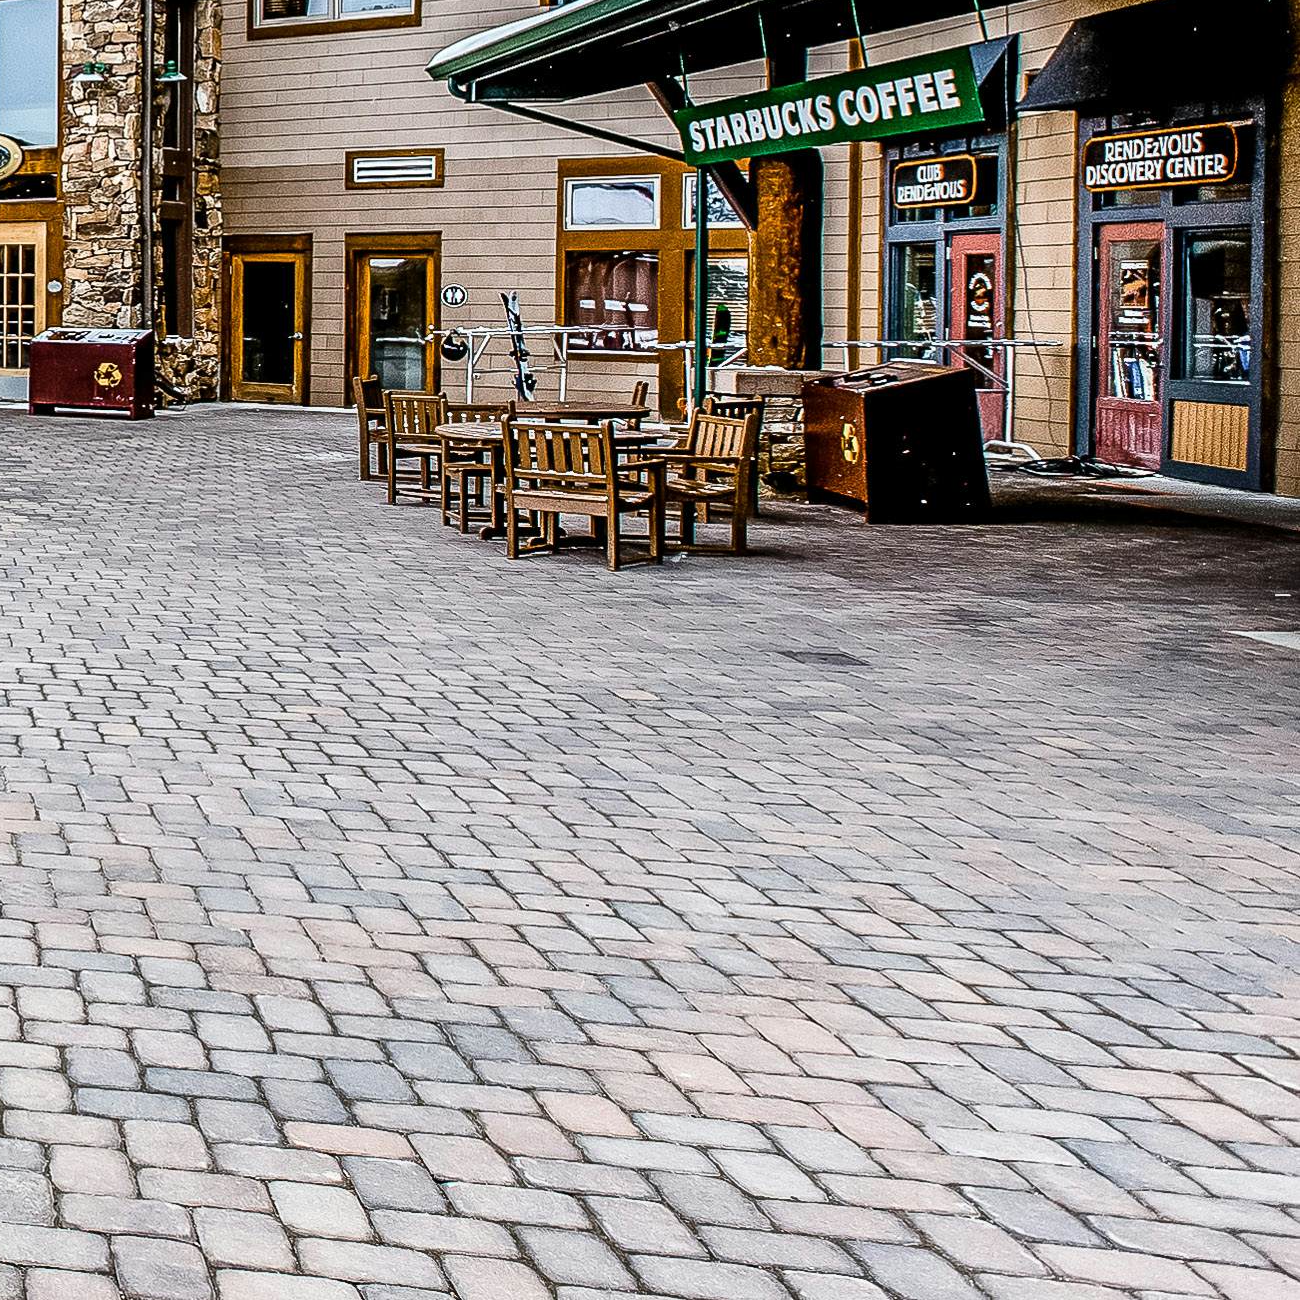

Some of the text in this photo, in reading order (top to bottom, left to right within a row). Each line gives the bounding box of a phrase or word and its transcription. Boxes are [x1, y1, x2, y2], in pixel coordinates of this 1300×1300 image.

[689, 69, 961, 151] STARBUCKS COFFEE
[1104, 132, 1204, 162] RENDEZVOUS
[917, 164, 945, 183] CLUB
[1086, 153, 1228, 186] DISCOVERY CENTER
[897, 179, 968, 203] RENDEZVOUS
